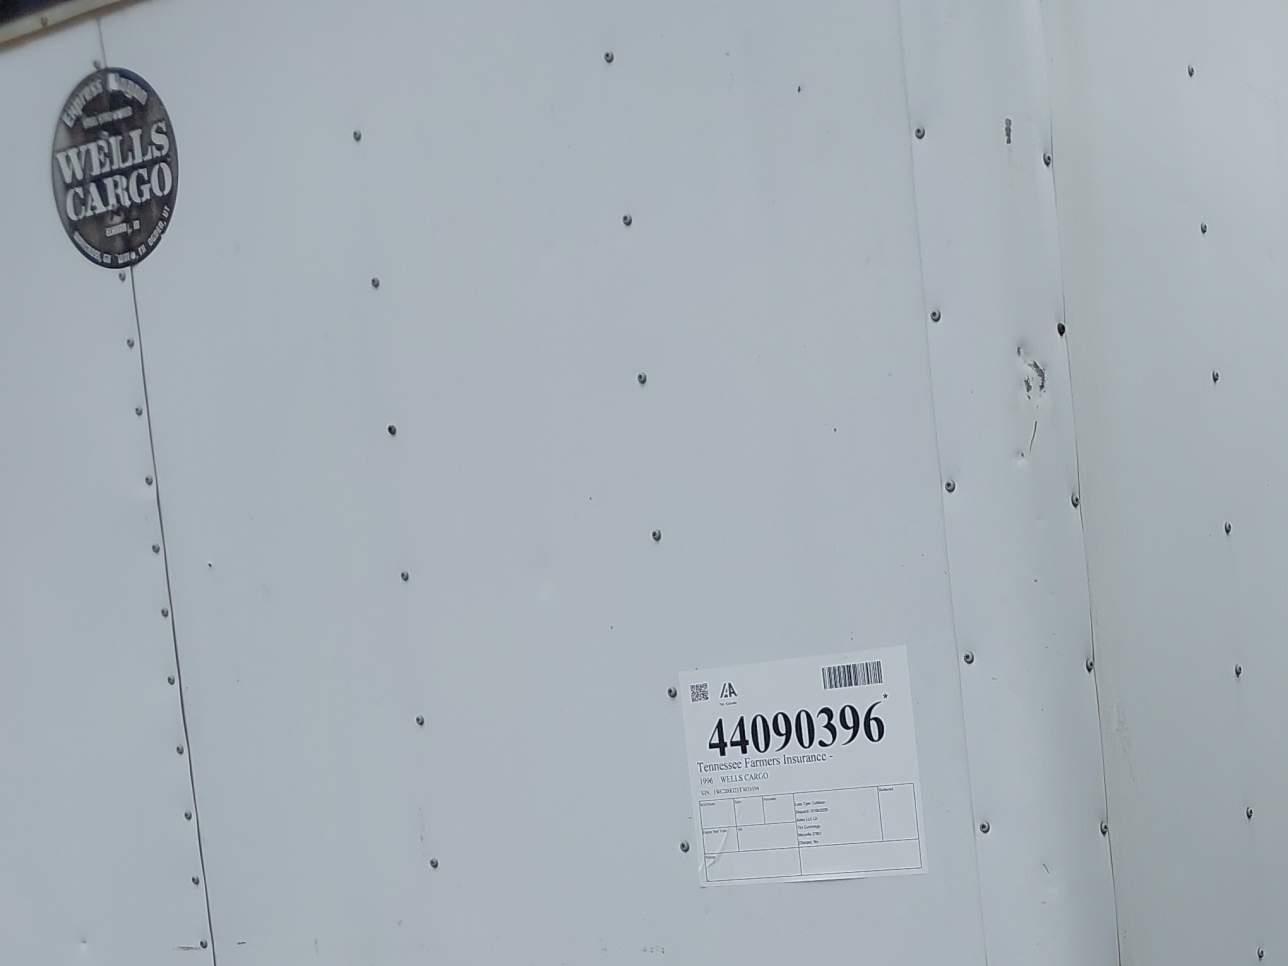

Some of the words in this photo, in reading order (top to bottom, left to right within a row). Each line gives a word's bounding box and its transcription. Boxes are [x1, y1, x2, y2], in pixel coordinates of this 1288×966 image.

[57, 120, 170, 184] WELLS
[66, 162, 173, 221] CARGO
[708, 701, 885, 756] 44090396
[697, 759, 742, 773] Tennessee
[745, 755, 781, 769] Farmers
[783, 753, 827, 765] Insurance
[700, 777, 714, 785] 1996
[720, 775, 743, 783] WELLS
[744, 772, 769, 781] CARGO
